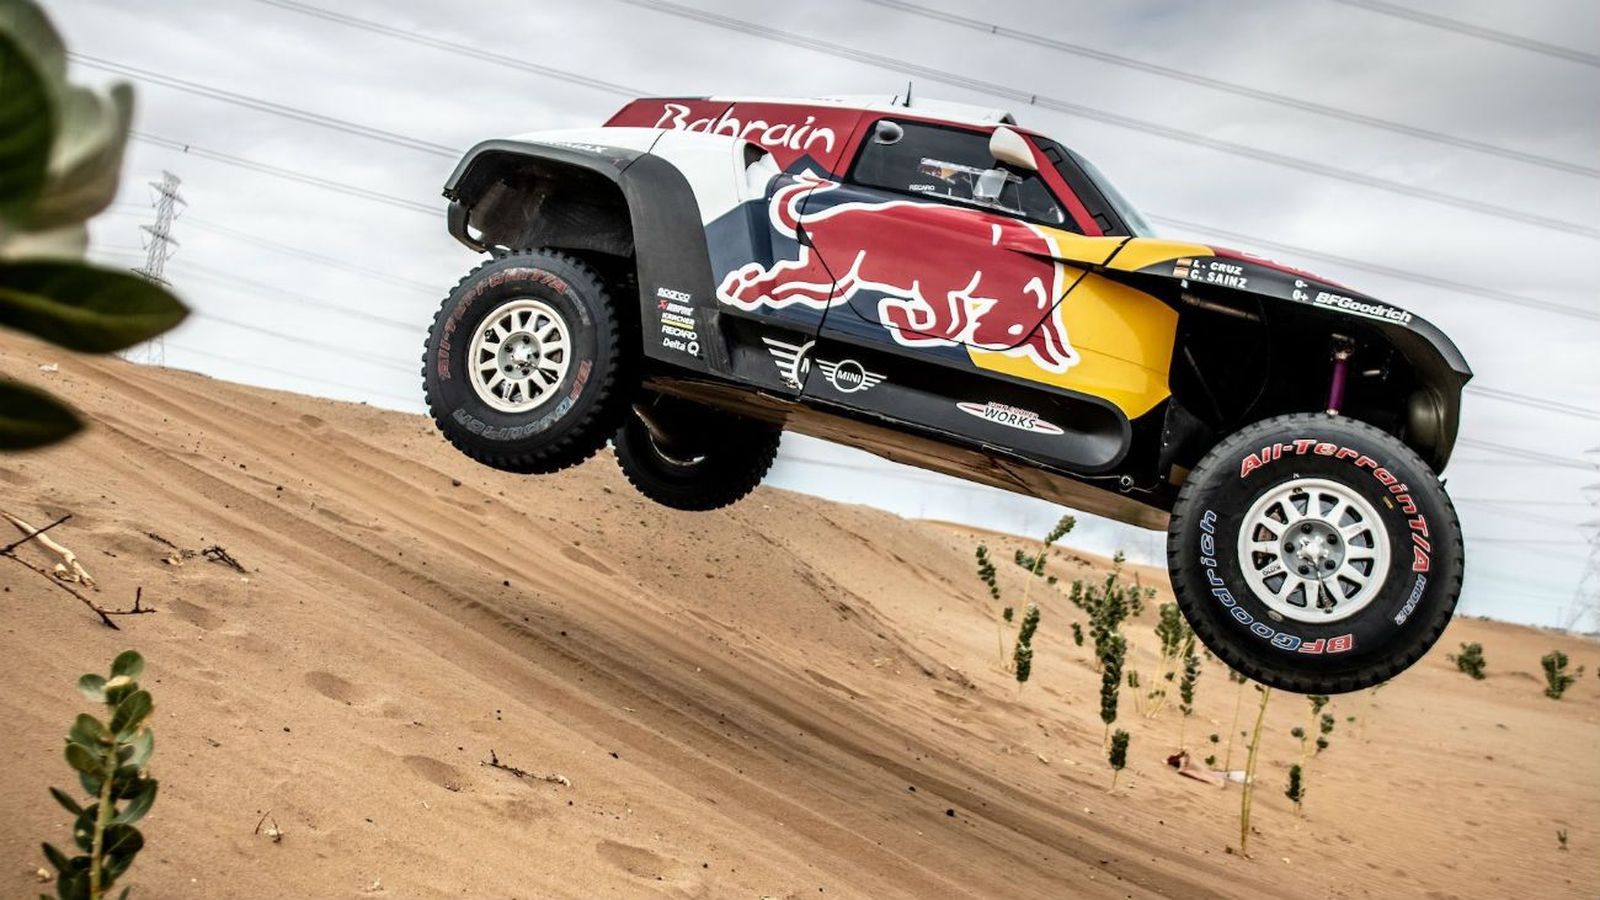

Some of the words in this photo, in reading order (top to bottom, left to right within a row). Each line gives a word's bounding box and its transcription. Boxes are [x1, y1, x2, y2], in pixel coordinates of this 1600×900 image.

[654, 103, 836, 153] Bahrain
[1210, 262, 1243, 275] CRUZ
[1190, 269, 1203, 280] C.
[1207, 271, 1248, 289] SAINZ
[1315, 292, 1412, 322] BFGoodrich
[662, 325, 697, 340] RECARO
[663, 338, 686, 351] Delta
[687, 341, 699, 357] Q
[837, 370, 861, 384] MINI
[984, 408, 1036, 429] WORKS
[1200, 509, 1353, 654] BFGoodrich
